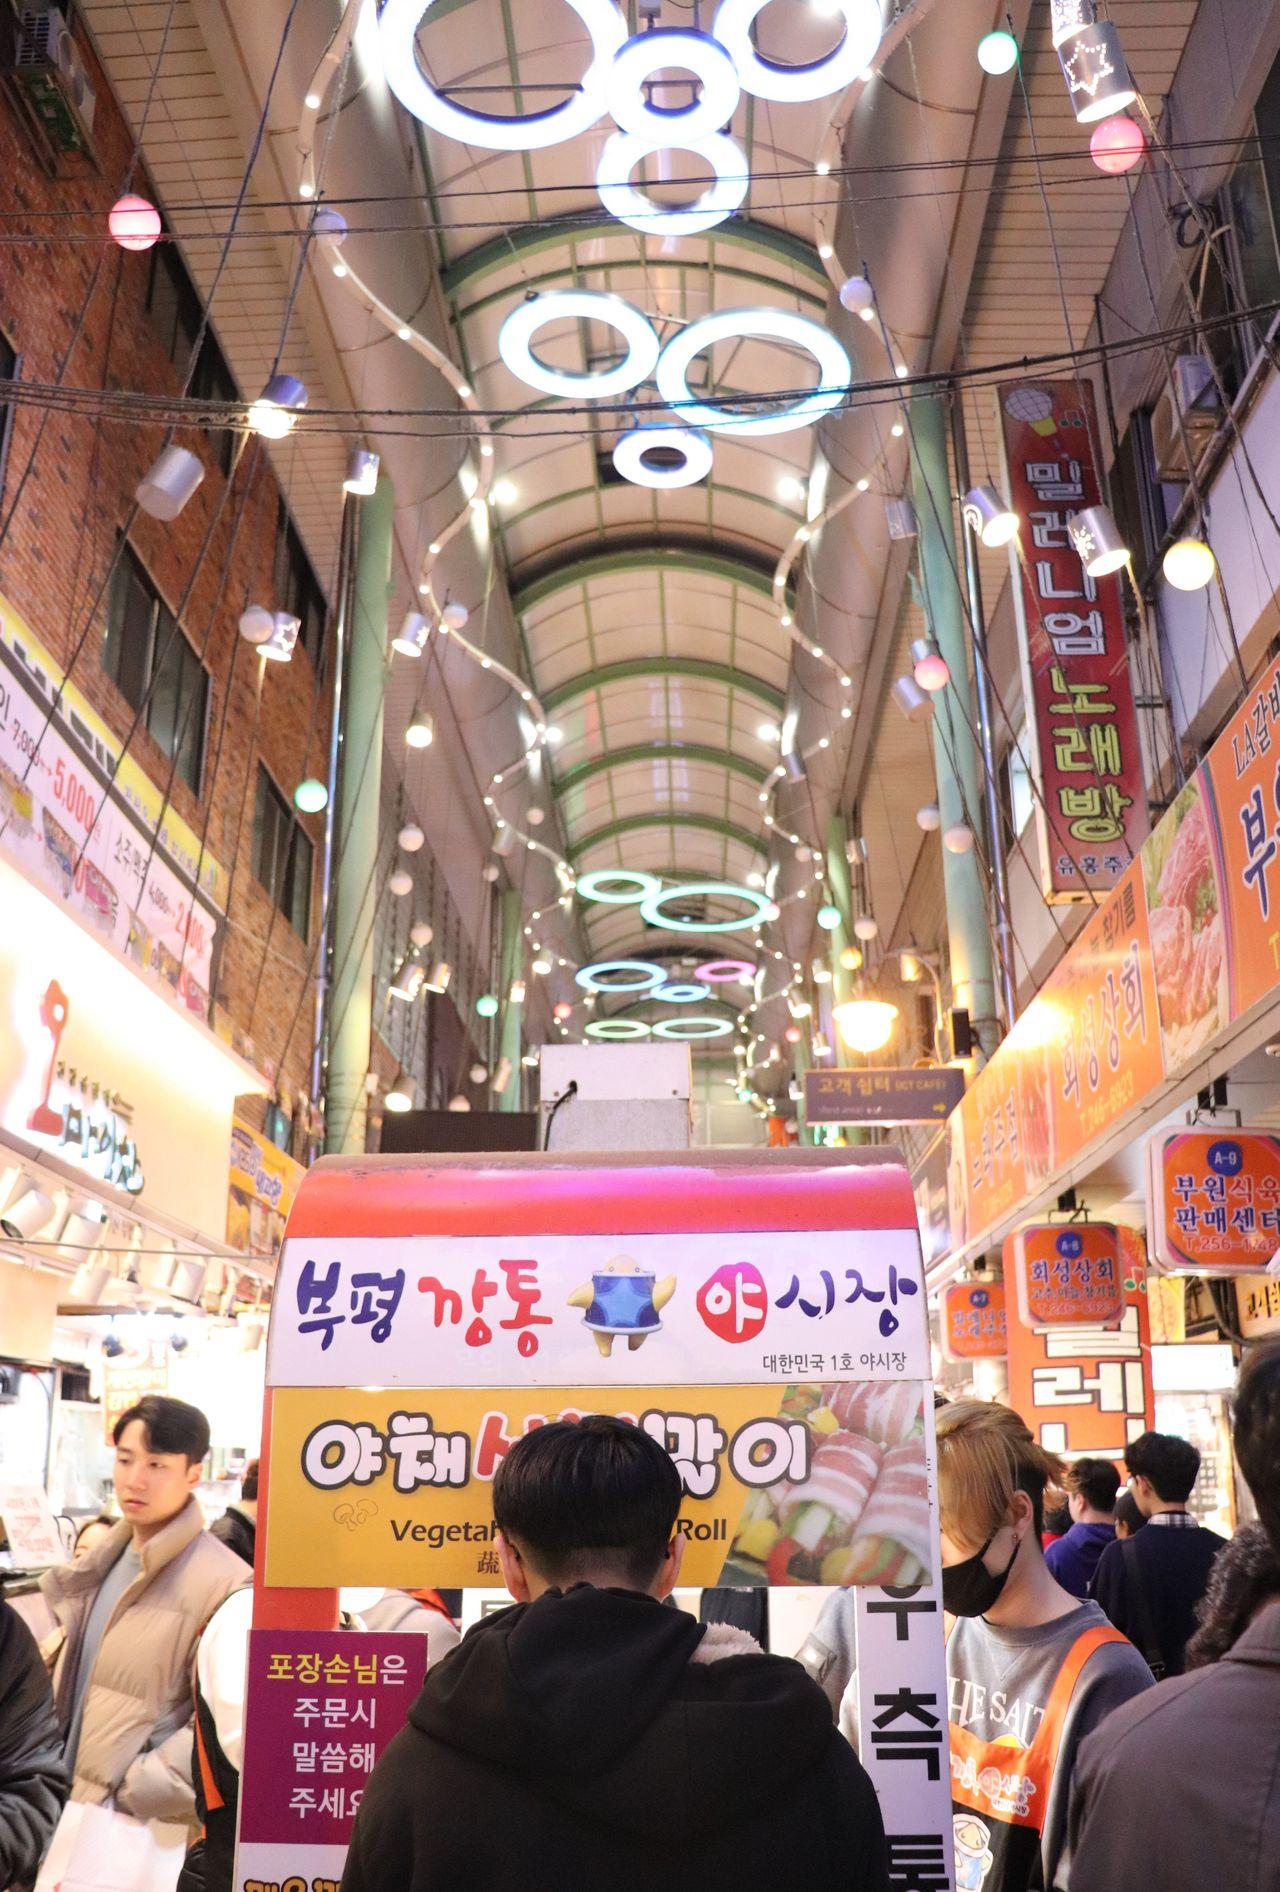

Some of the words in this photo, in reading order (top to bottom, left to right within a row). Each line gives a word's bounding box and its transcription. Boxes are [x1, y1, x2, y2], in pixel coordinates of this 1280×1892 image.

[1049, 664, 1133, 843] 노래방
[1241, 758, 1280, 922] 부
[1057, 856, 1133, 878] 유흥주
[1214, 1152, 1237, 1165] A-9
[1174, 1175, 1280, 1204] 부원식육
[1176, 1206, 1280, 1235] 판매센터
[297, 1259, 405, 1352] 부평
[417, 1258, 553, 1358] 깡통
[763, 1353, 825, 1375] 대한민국
[831, 1353, 854, 1371] 1호
[860, 1352, 907, 1372] 야시장
[677, 1518, 727, 1541] Roll
[477, 1550, 502, 1575] 蔬
[267, 1653, 408, 1685] 포장손님은
[293, 1698, 376, 1729] 주문시
[293, 1742, 376, 1774] 말씀해
